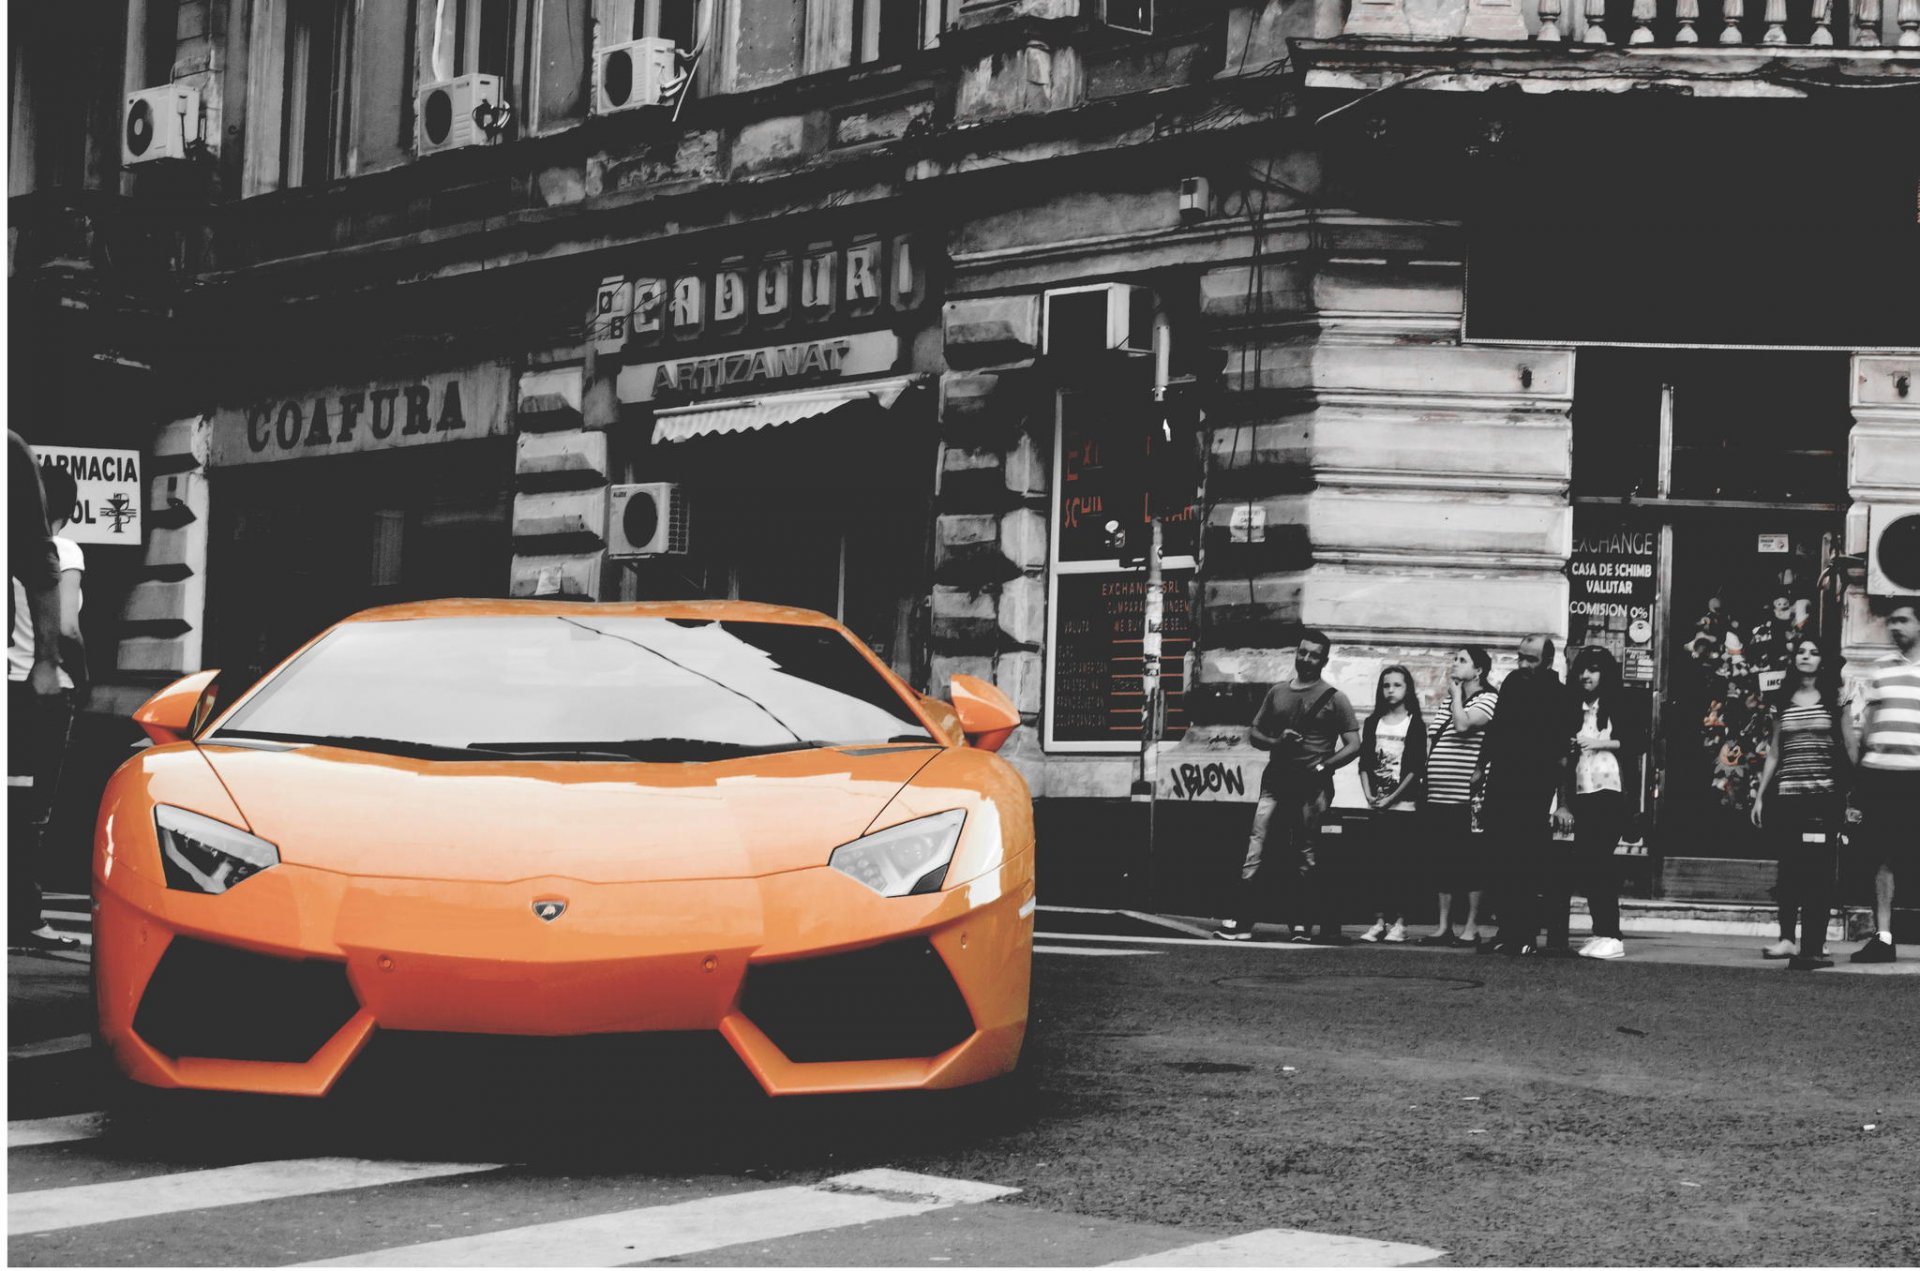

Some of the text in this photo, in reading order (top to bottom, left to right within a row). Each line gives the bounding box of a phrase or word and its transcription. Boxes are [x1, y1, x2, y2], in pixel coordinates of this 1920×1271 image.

[652, 340, 850, 397] ARTIZANAT
[247, 381, 466, 452] COAFURA
[1571, 561, 1652, 578] CASA DE SCHIMB
[1586, 579, 1633, 595] VALUTAR
[1569, 600, 1648, 619] COMISION 0%
